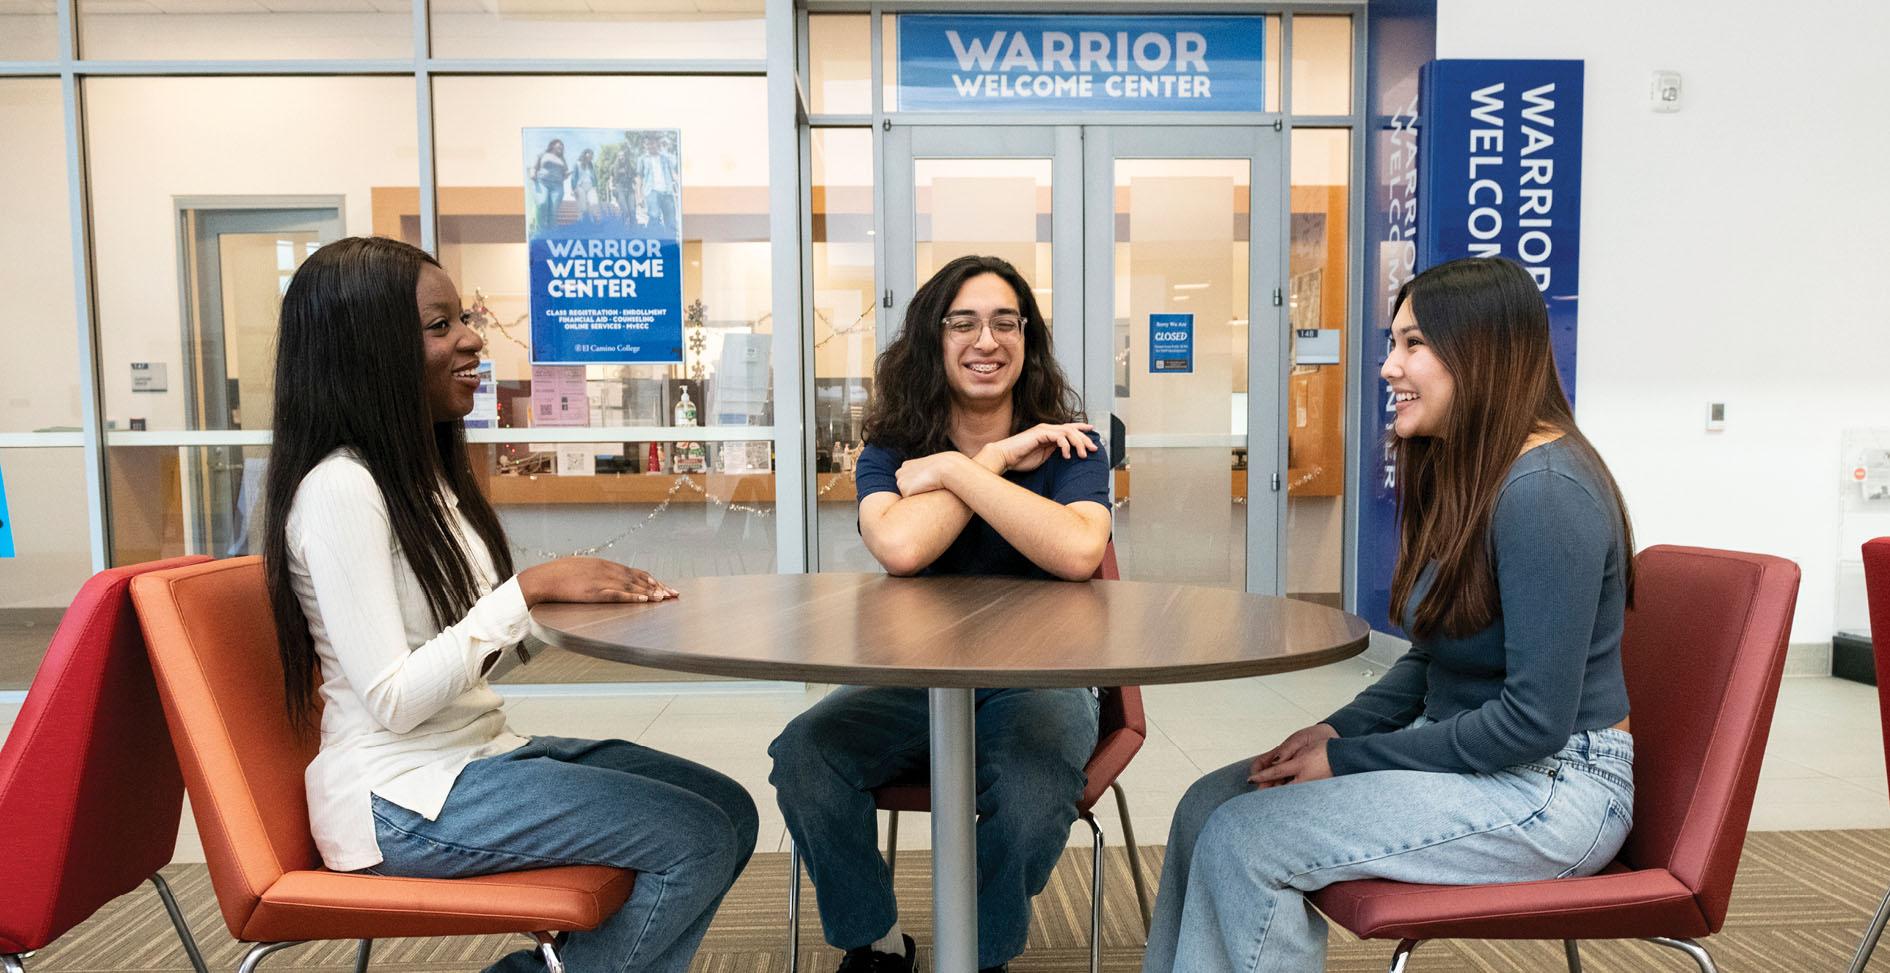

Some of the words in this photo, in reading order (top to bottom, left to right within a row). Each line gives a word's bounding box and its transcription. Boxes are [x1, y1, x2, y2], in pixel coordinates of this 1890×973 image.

[945, 30, 1209, 72] WARRIOR
[952, 75, 1093, 98] WELCOME
[1105, 75, 1212, 98] CENTER
[1467, 82, 1504, 259] WELCO
[1404, 95, 1418, 284] WARRIO
[546, 239, 662, 258] WARRIOR
[546, 259, 664, 278] WELCOME
[548, 279, 637, 298] CENTER
[1154, 332, 1188, 341] CLOSED
[582, 344, 590, 352] El
[590, 344, 616, 352] Camino
[617, 344, 641, 354] College
